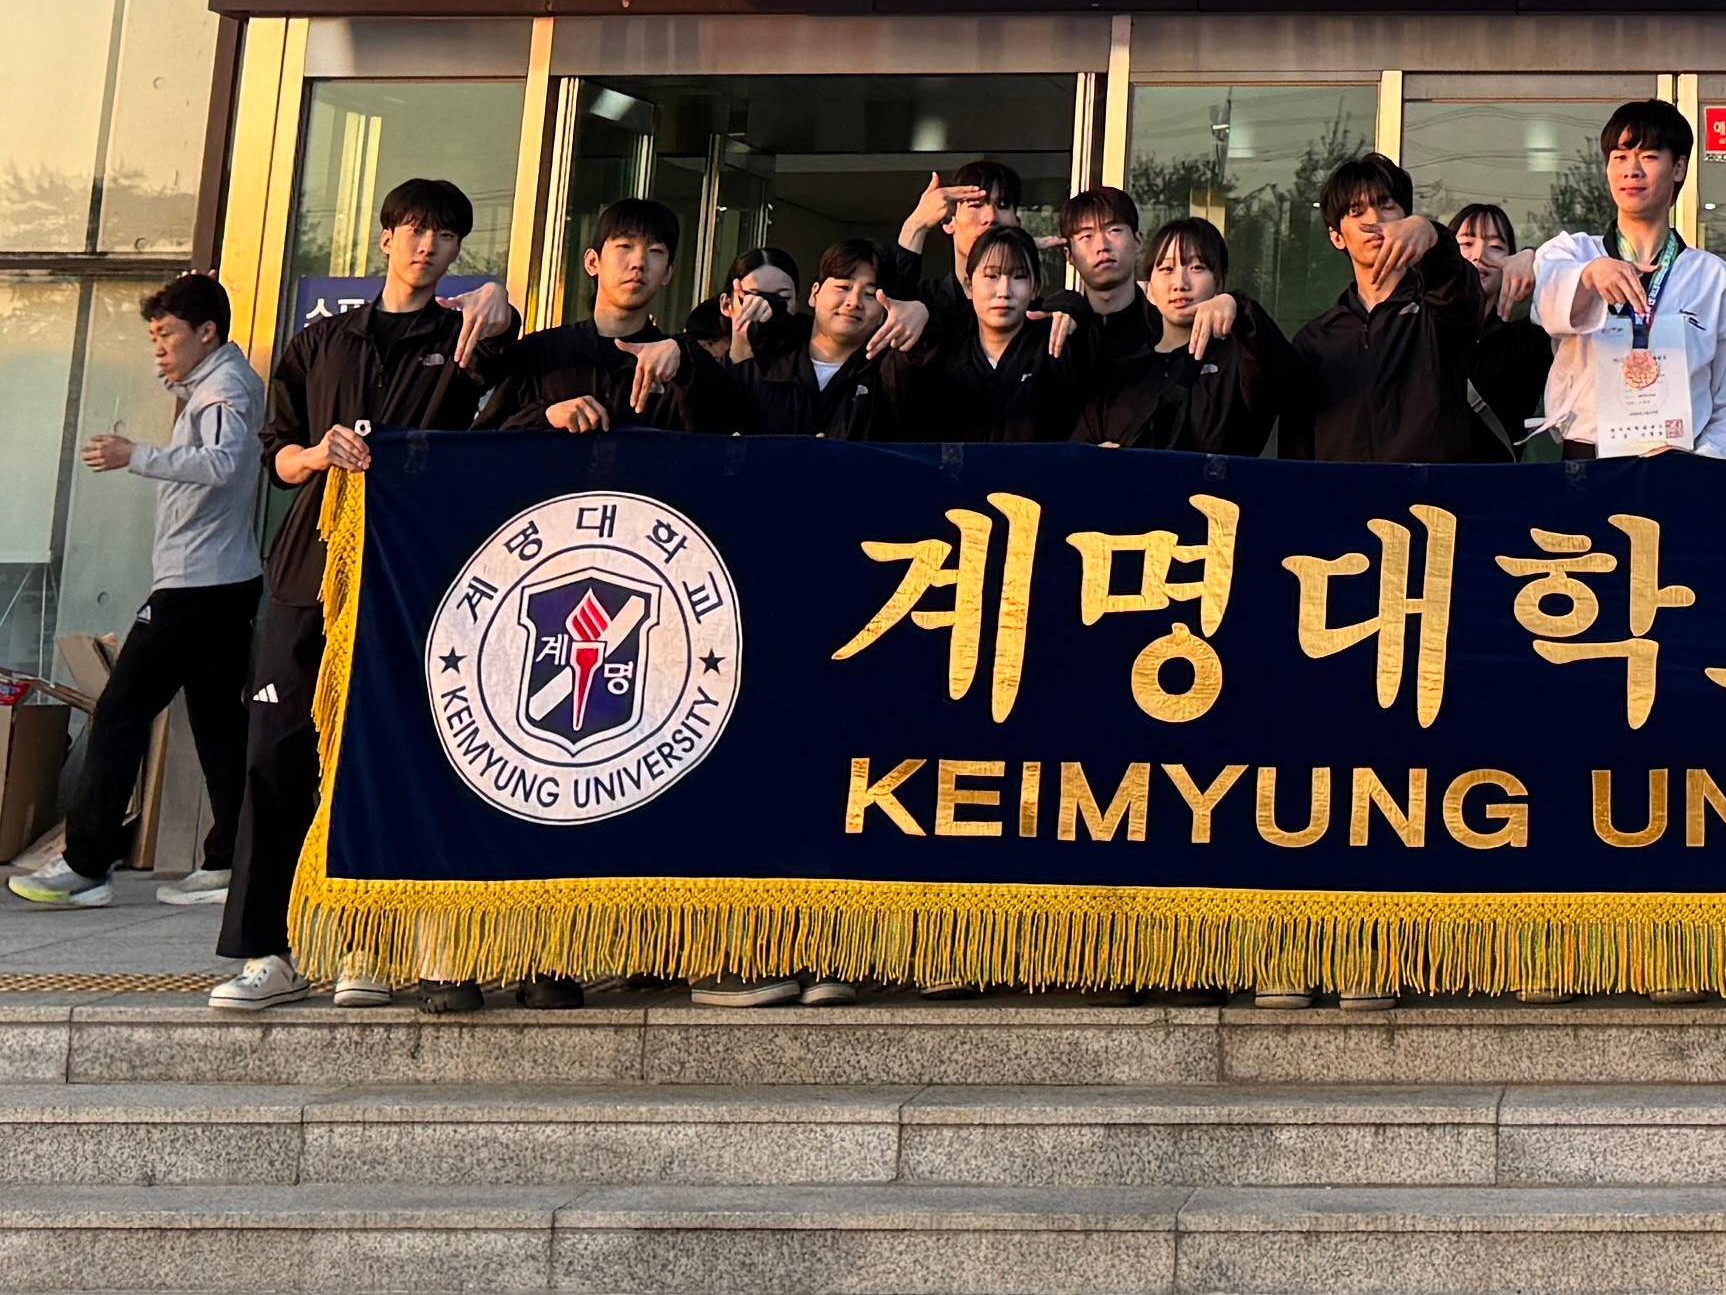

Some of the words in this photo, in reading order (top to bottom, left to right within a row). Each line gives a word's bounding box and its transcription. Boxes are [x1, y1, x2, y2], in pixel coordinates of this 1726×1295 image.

[456, 504, 724, 624] 계명대학교
[440, 685, 560, 807] KEIMYUNG
[573, 686, 719, 808] UNIVERSITY
[845, 758, 1530, 849] KEIMYUNG
